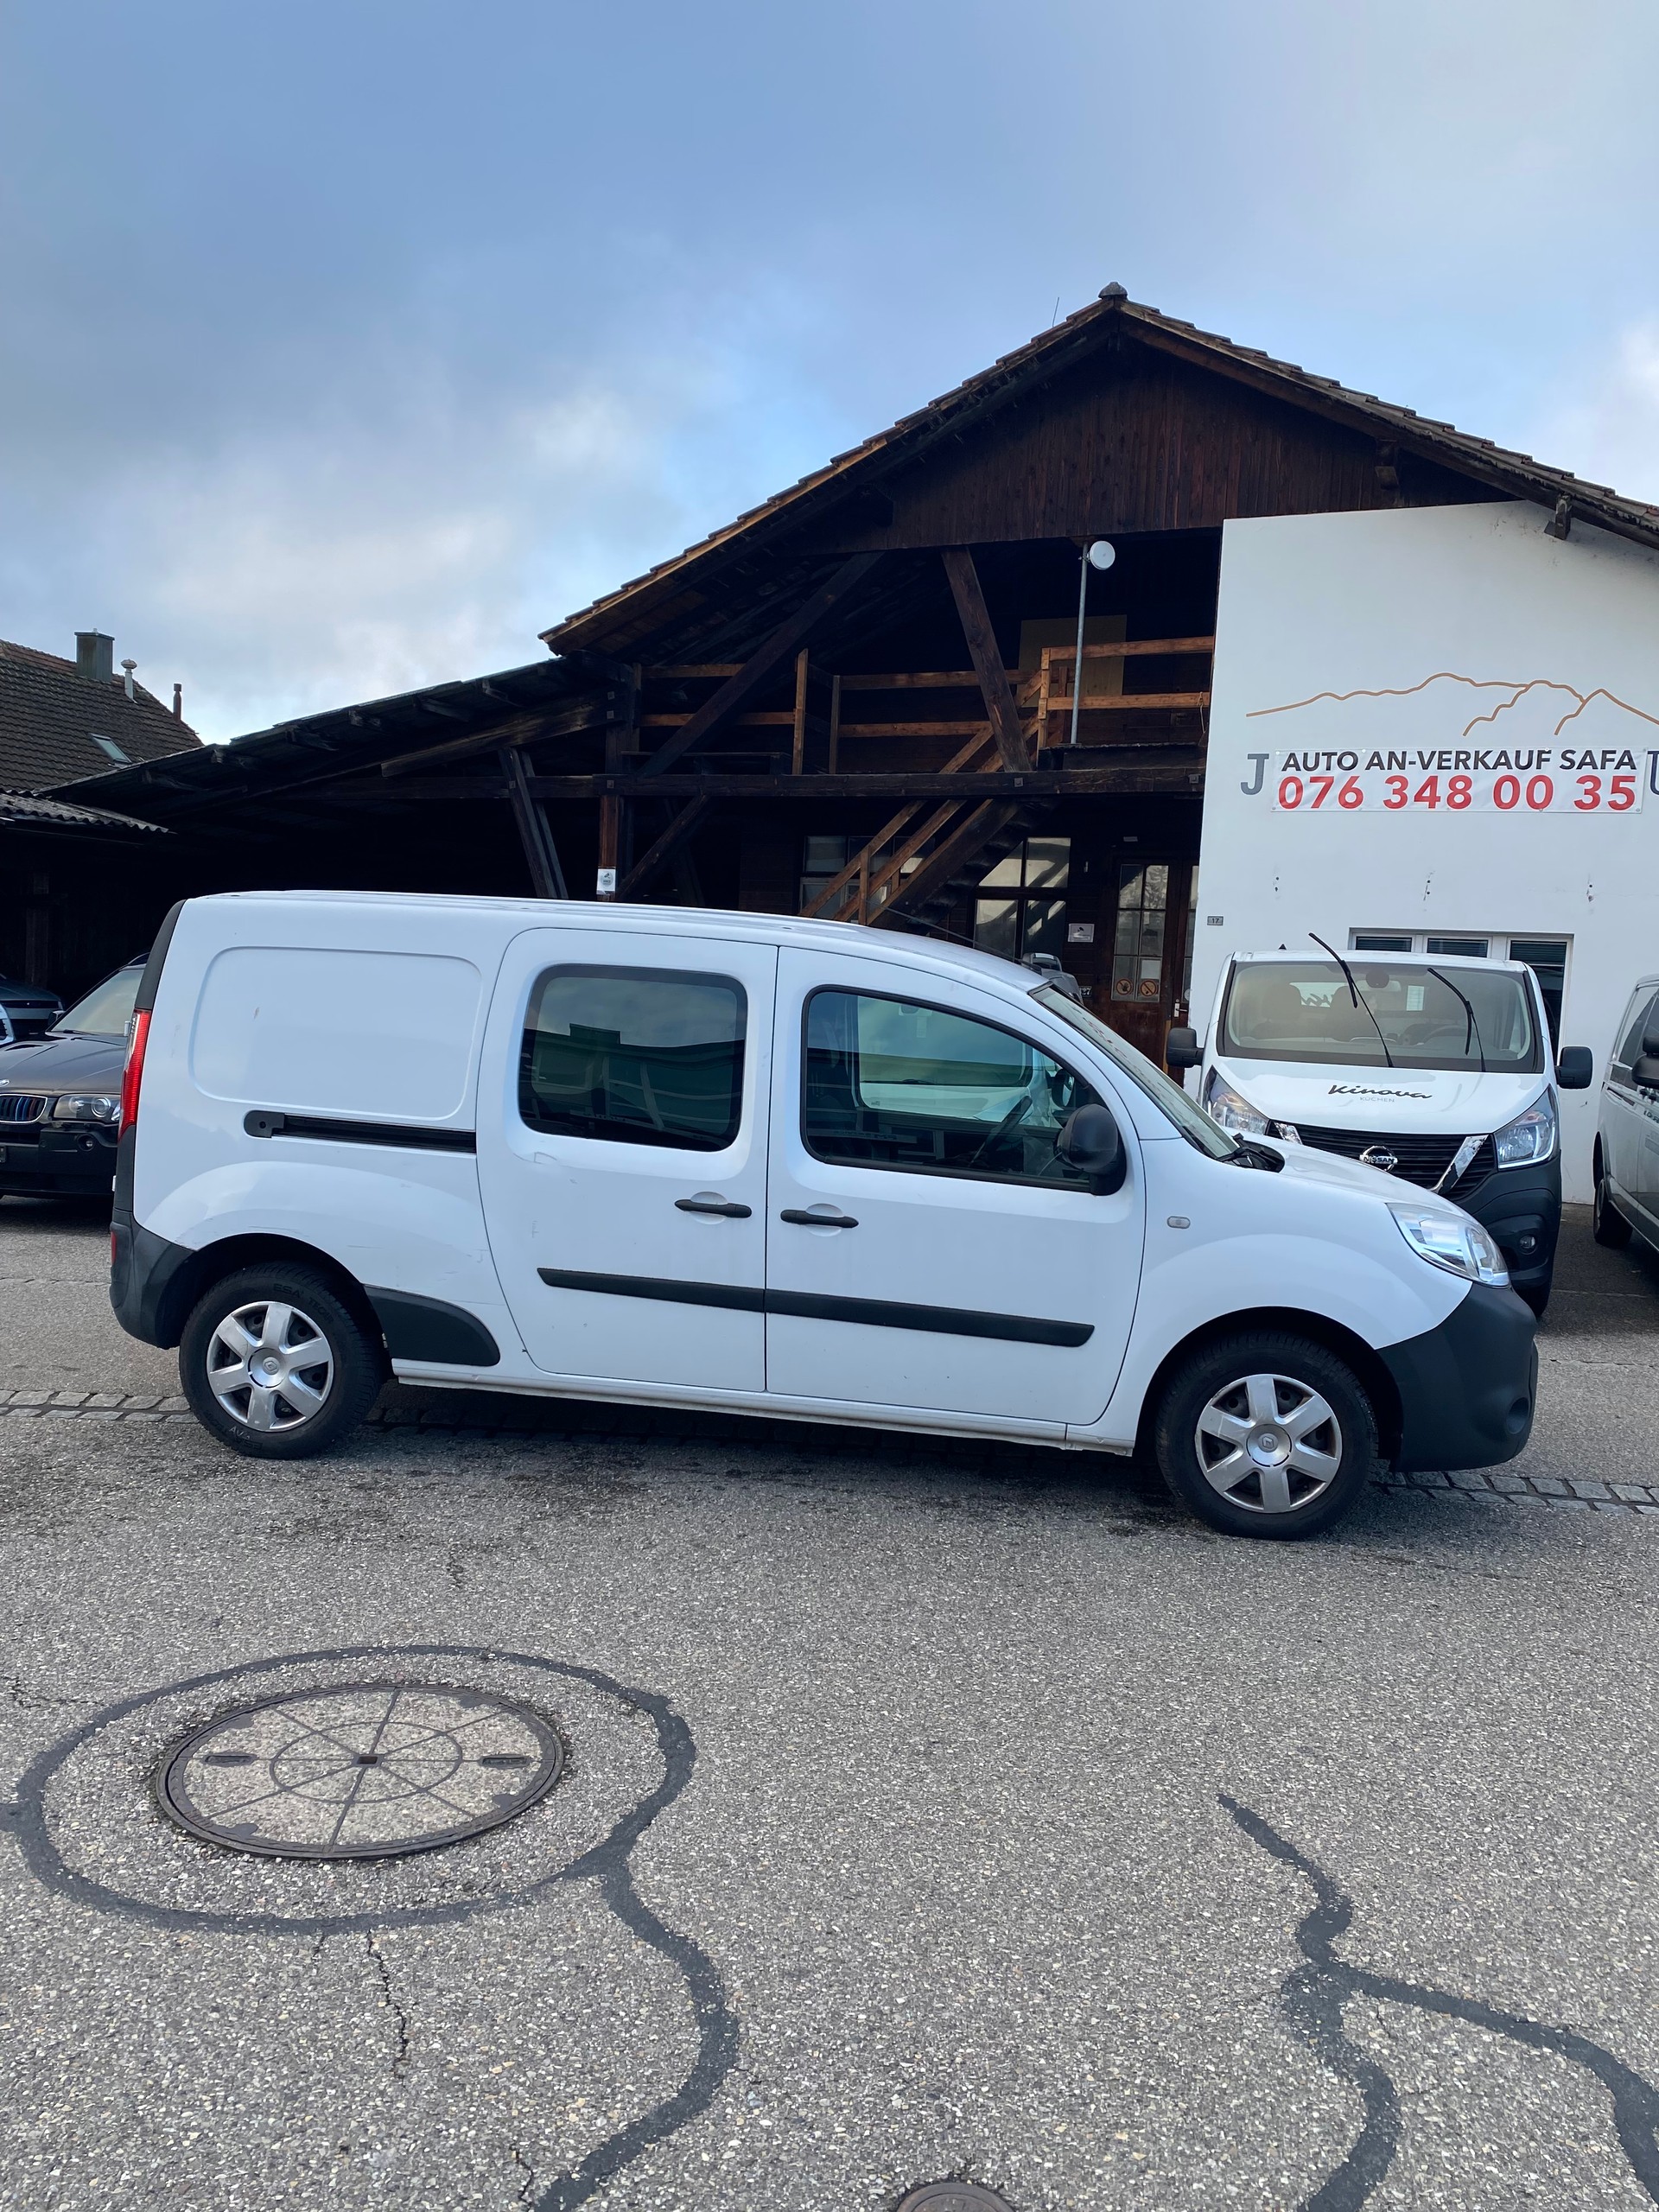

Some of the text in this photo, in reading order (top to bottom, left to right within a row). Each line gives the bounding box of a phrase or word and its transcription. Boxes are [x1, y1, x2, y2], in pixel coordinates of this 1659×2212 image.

[1281, 748, 1637, 772] AUTO AN-VERKAUF SAFA
[1277, 774, 1637, 811] 076 348 00 35
[1328, 1084, 1433, 1099] Kinova
[1363, 1155, 1395, 1164] NISSAN
